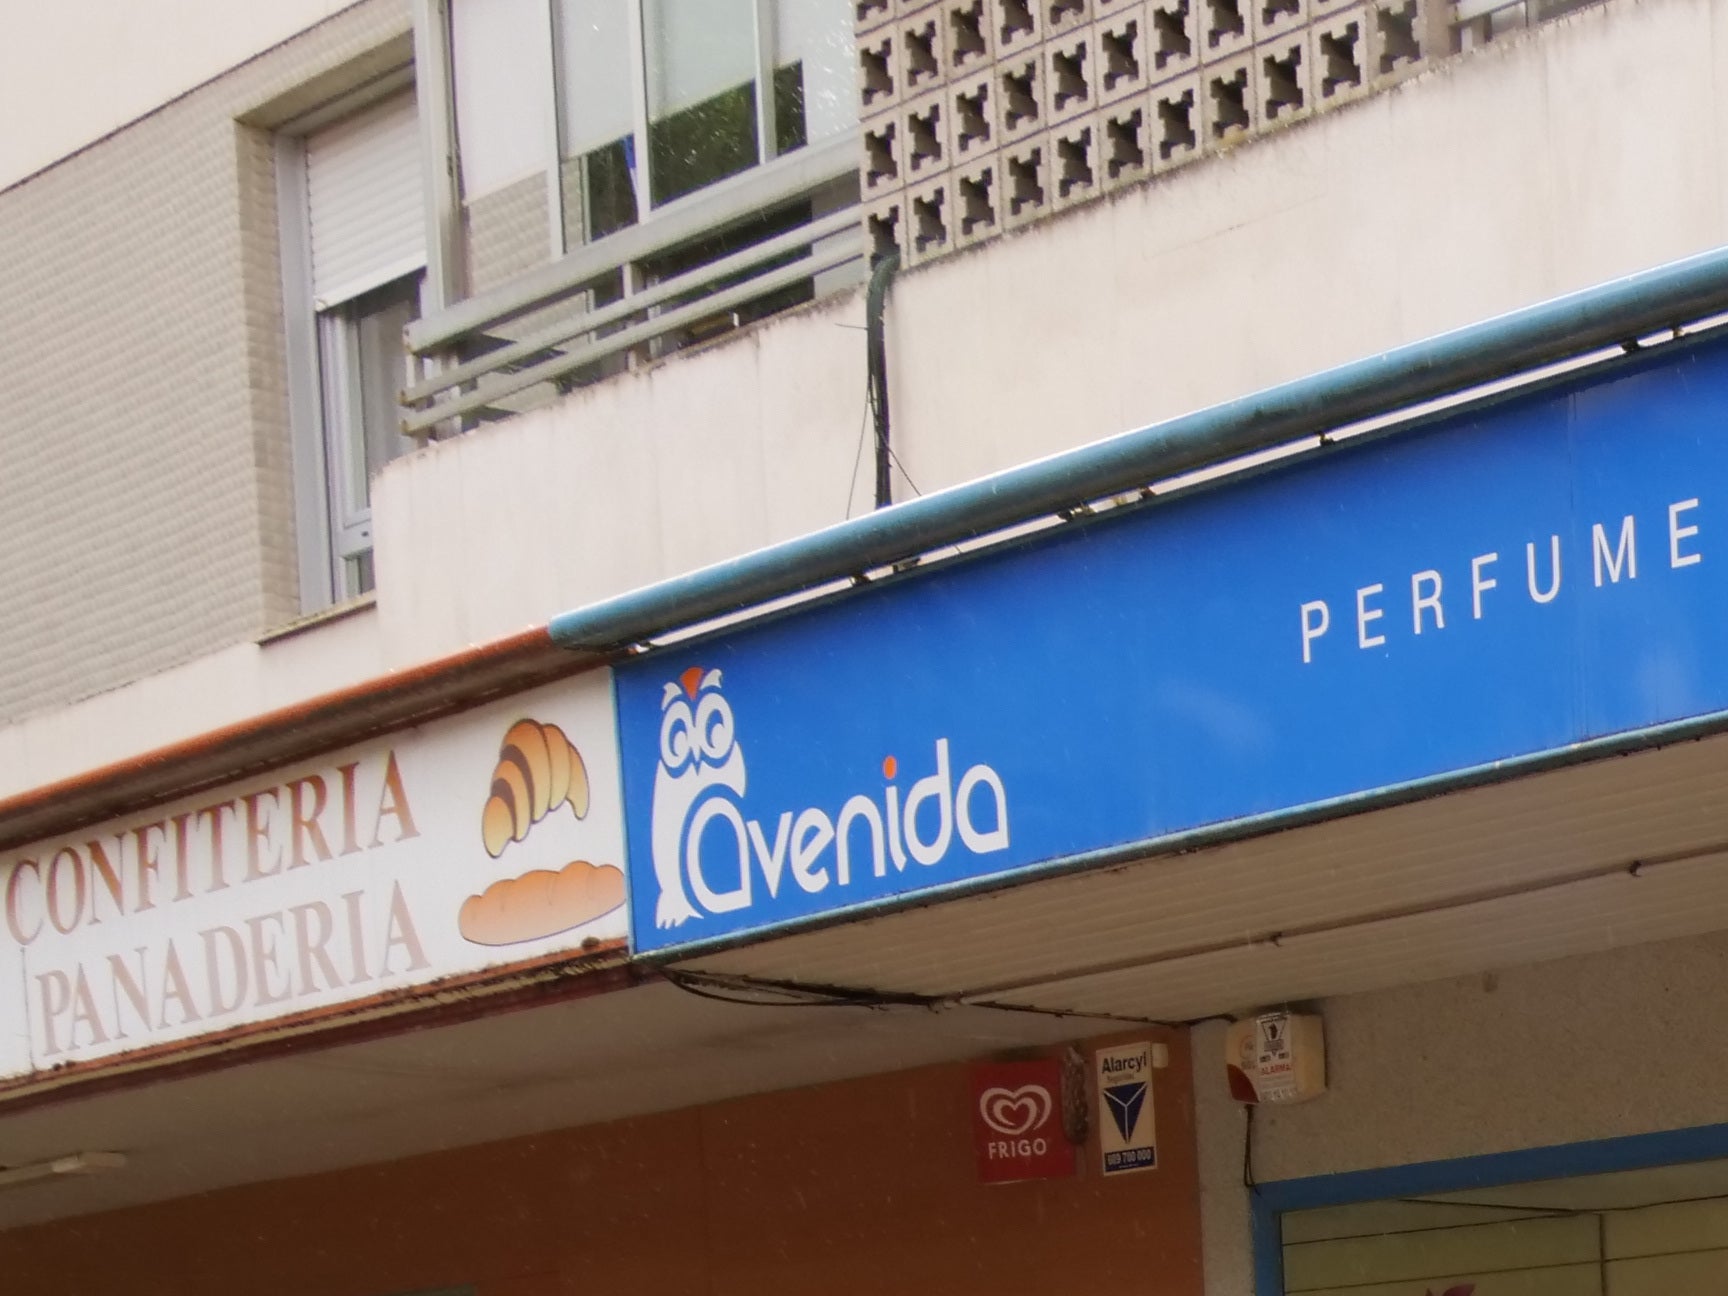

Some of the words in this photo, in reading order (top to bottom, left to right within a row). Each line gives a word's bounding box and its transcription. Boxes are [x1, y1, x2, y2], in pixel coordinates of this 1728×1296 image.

[6, 750, 420, 947] CONFITERIA
[35, 879, 431, 1058] PANADERIA
[988, 1138, 1048, 1160] FRIGO
